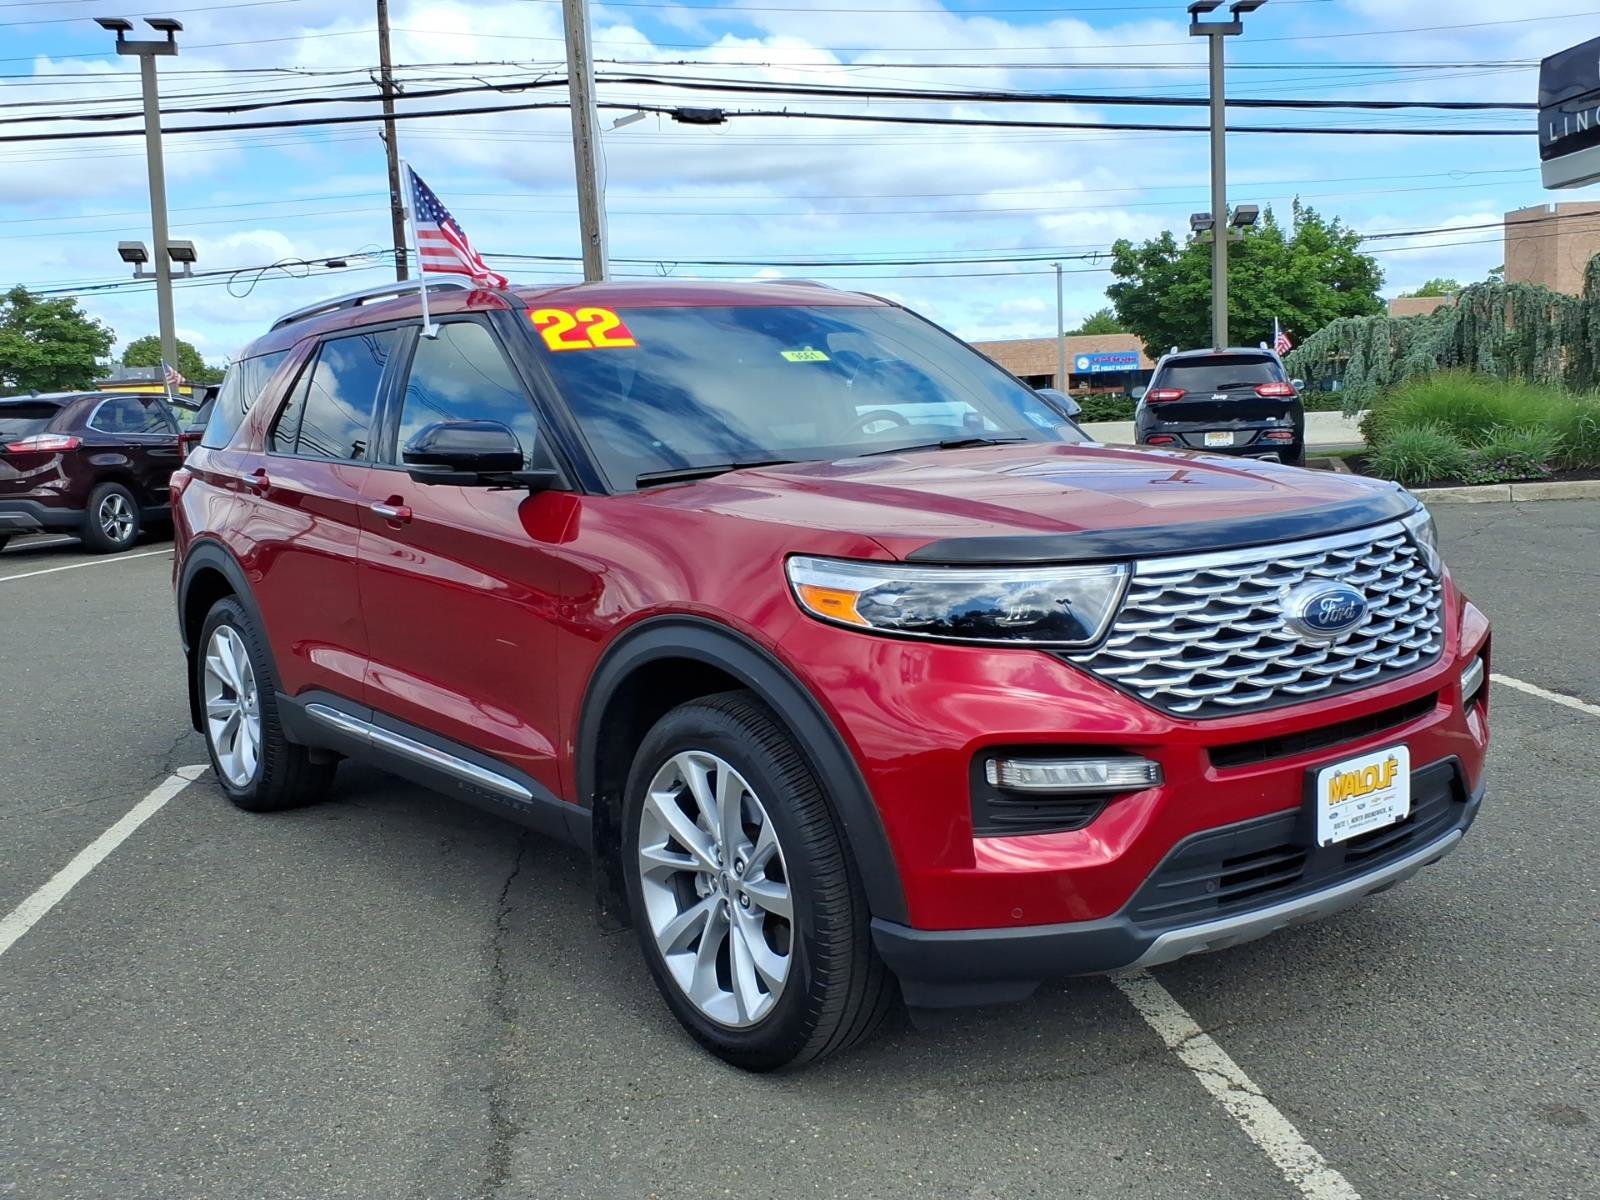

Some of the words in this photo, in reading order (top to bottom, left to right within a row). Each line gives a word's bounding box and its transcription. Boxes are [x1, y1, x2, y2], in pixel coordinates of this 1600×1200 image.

[530, 307, 637, 351] 22
[1318, 596, 1356, 624] Ford
[1328, 758, 1398, 806] MALOUF
